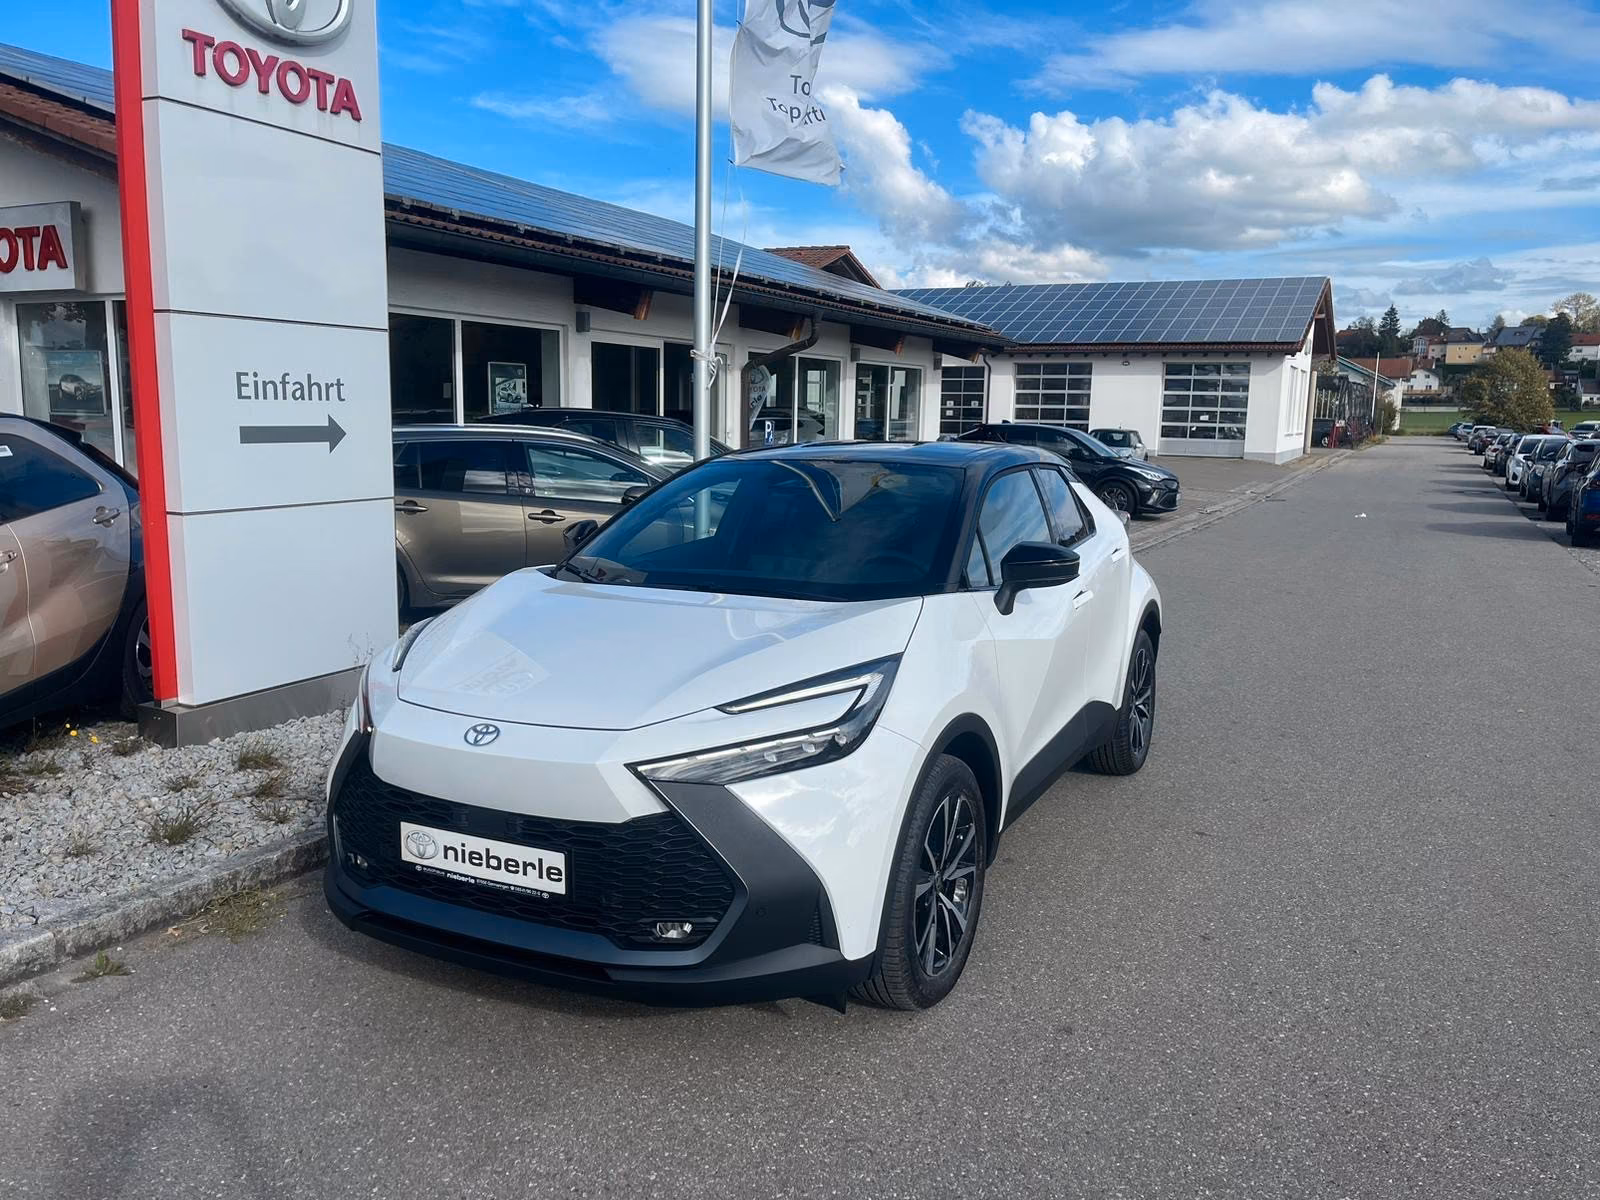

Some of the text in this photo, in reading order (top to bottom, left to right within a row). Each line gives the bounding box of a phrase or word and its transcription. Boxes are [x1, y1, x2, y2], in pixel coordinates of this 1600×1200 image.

[182, 28, 362, 122] TOYOTA
[235, 371, 346, 402] Einfahrt
[443, 842, 563, 883] nieberle
[446, 872, 475, 884] nieberle
